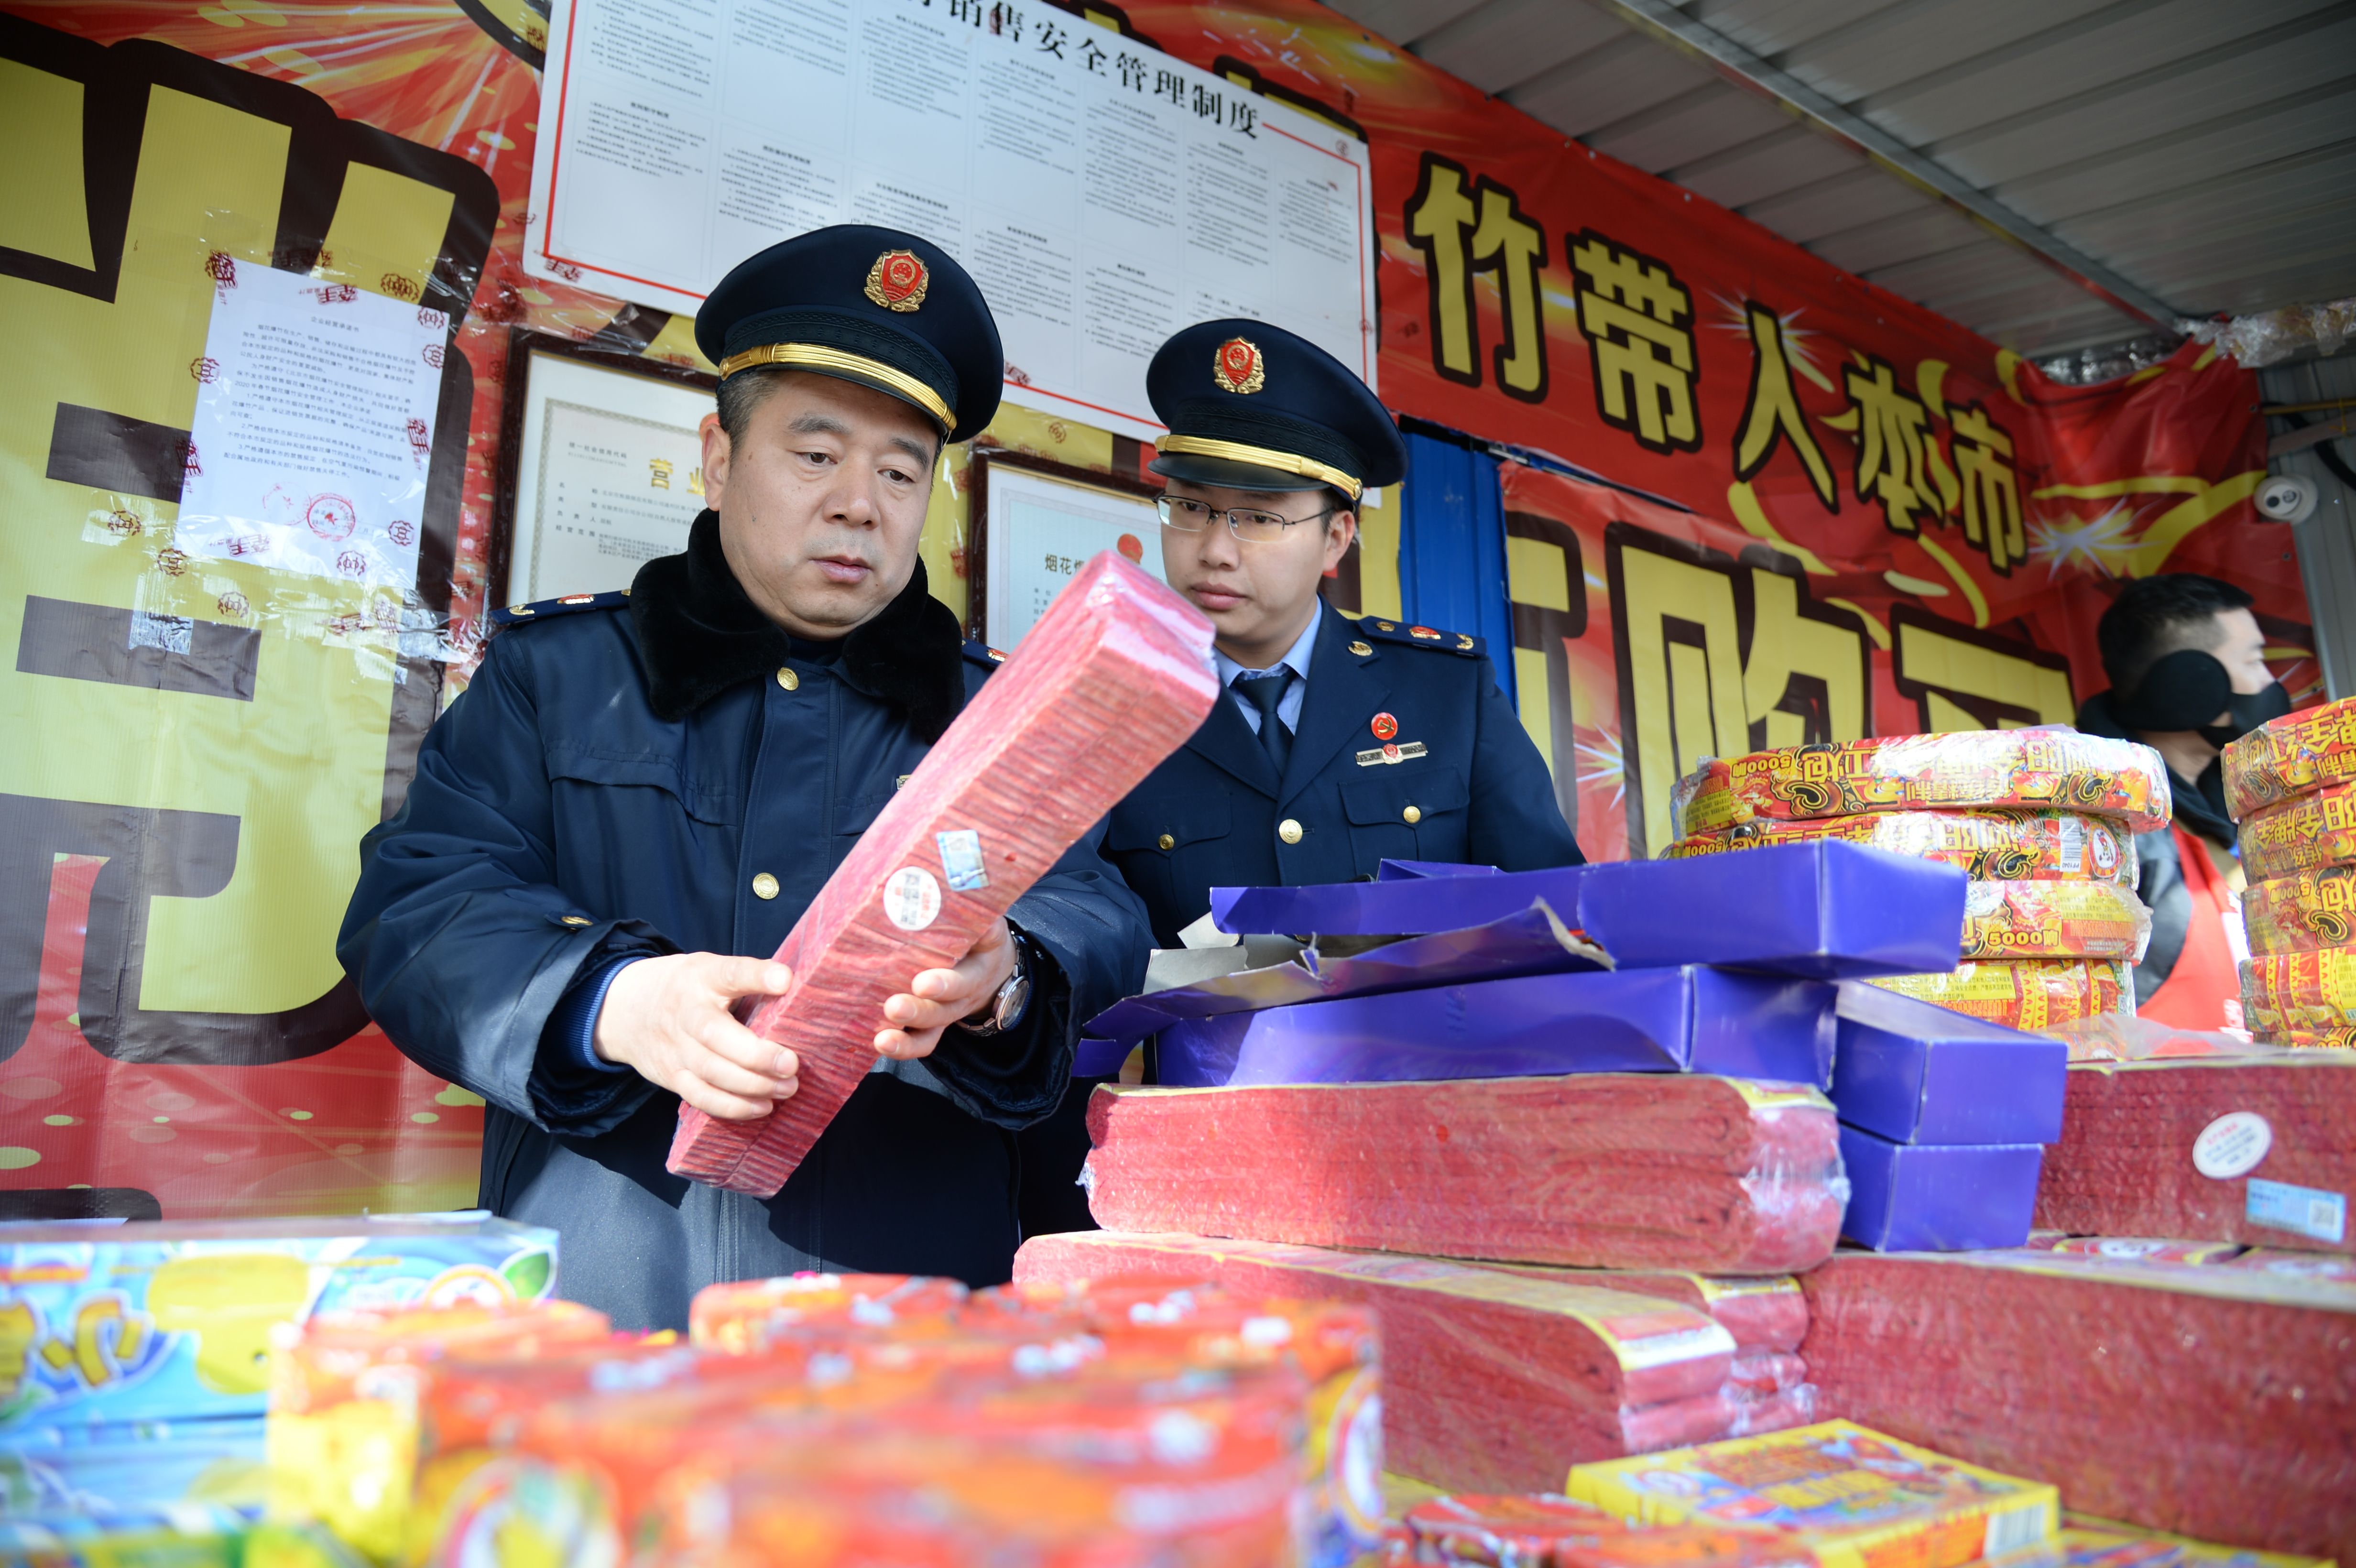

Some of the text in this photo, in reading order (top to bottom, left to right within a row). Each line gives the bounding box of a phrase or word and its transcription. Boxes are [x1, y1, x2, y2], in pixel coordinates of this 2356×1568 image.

[904, 0, 1259, 139] 销售安全管理制度
[317, 285, 359, 305] 牵手
[311, 316, 359, 332] 企业经营承诺书
[406, 417, 431, 454] 牵手
[1731, 755, 1792, 779] 5000响
[1987, 929, 2059, 947] 5000响
